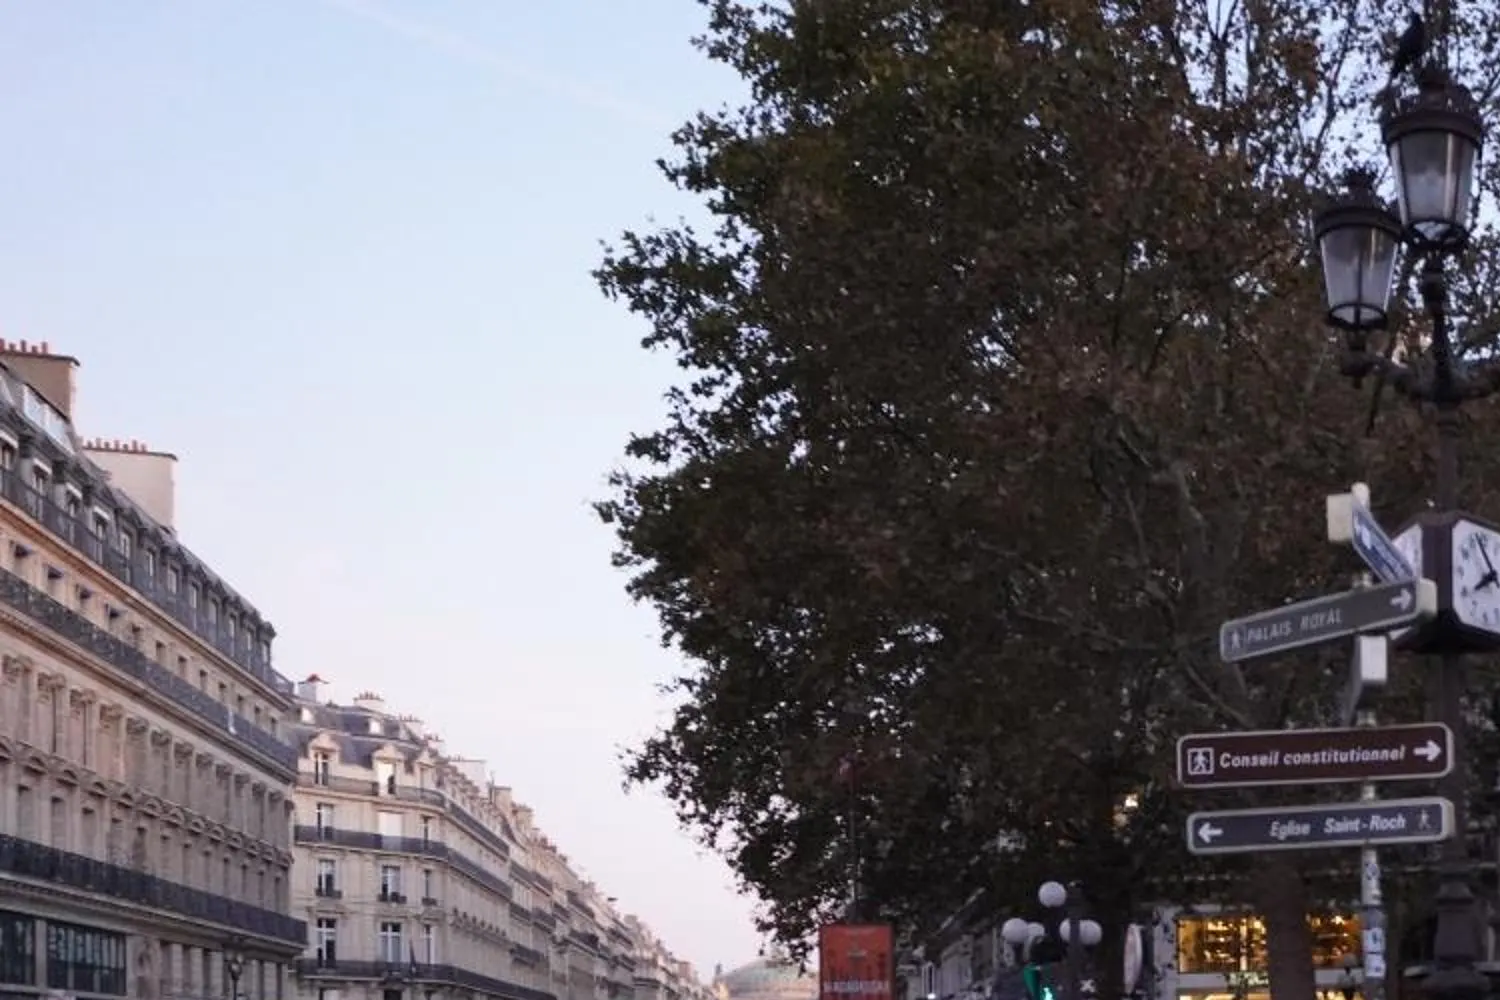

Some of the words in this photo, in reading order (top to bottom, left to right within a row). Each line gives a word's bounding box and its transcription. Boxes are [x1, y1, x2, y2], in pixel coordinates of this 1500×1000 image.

[1301, 610, 1342, 630] ROYAL
[1219, 750, 1280, 769] Conseil
[1283, 746, 1405, 765] constitutionnel
